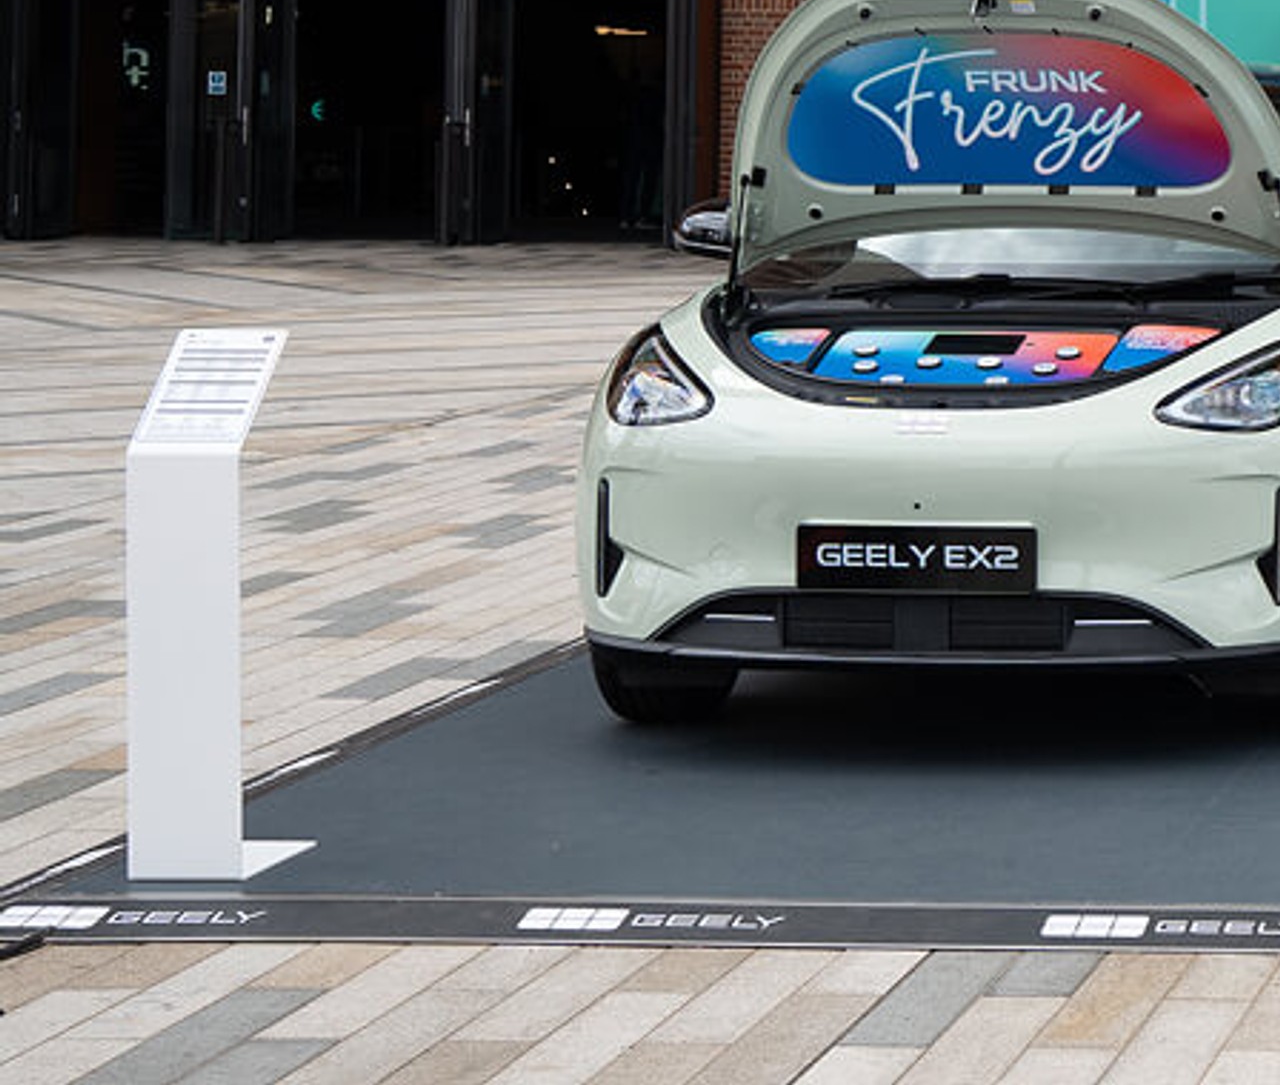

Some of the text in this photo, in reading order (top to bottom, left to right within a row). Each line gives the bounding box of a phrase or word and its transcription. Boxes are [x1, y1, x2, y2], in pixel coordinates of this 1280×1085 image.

[964, 70, 1107, 93] FRUNK
[852, 47, 1143, 176] Frenzy
[816, 542, 1019, 570] GEELY EX2
[106, 910, 267, 924] GEELY
[630, 913, 785, 929] GEELY
